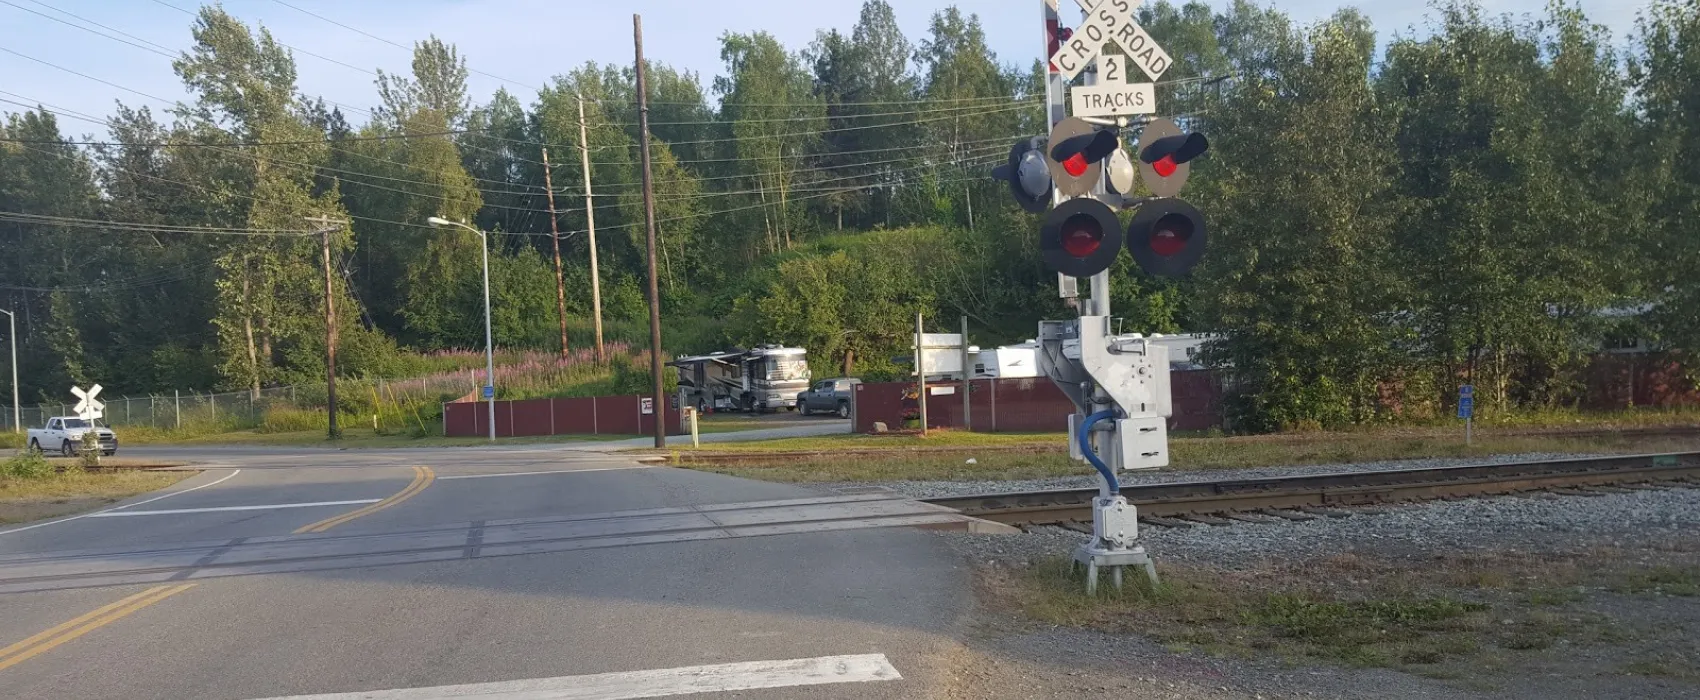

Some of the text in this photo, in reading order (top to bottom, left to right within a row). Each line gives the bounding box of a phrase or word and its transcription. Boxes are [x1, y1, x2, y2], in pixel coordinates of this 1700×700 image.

[1117, 22, 1166, 75] ROAD
[1106, 60, 1118, 81] 2
[1082, 91, 1145, 109] TRACKS
